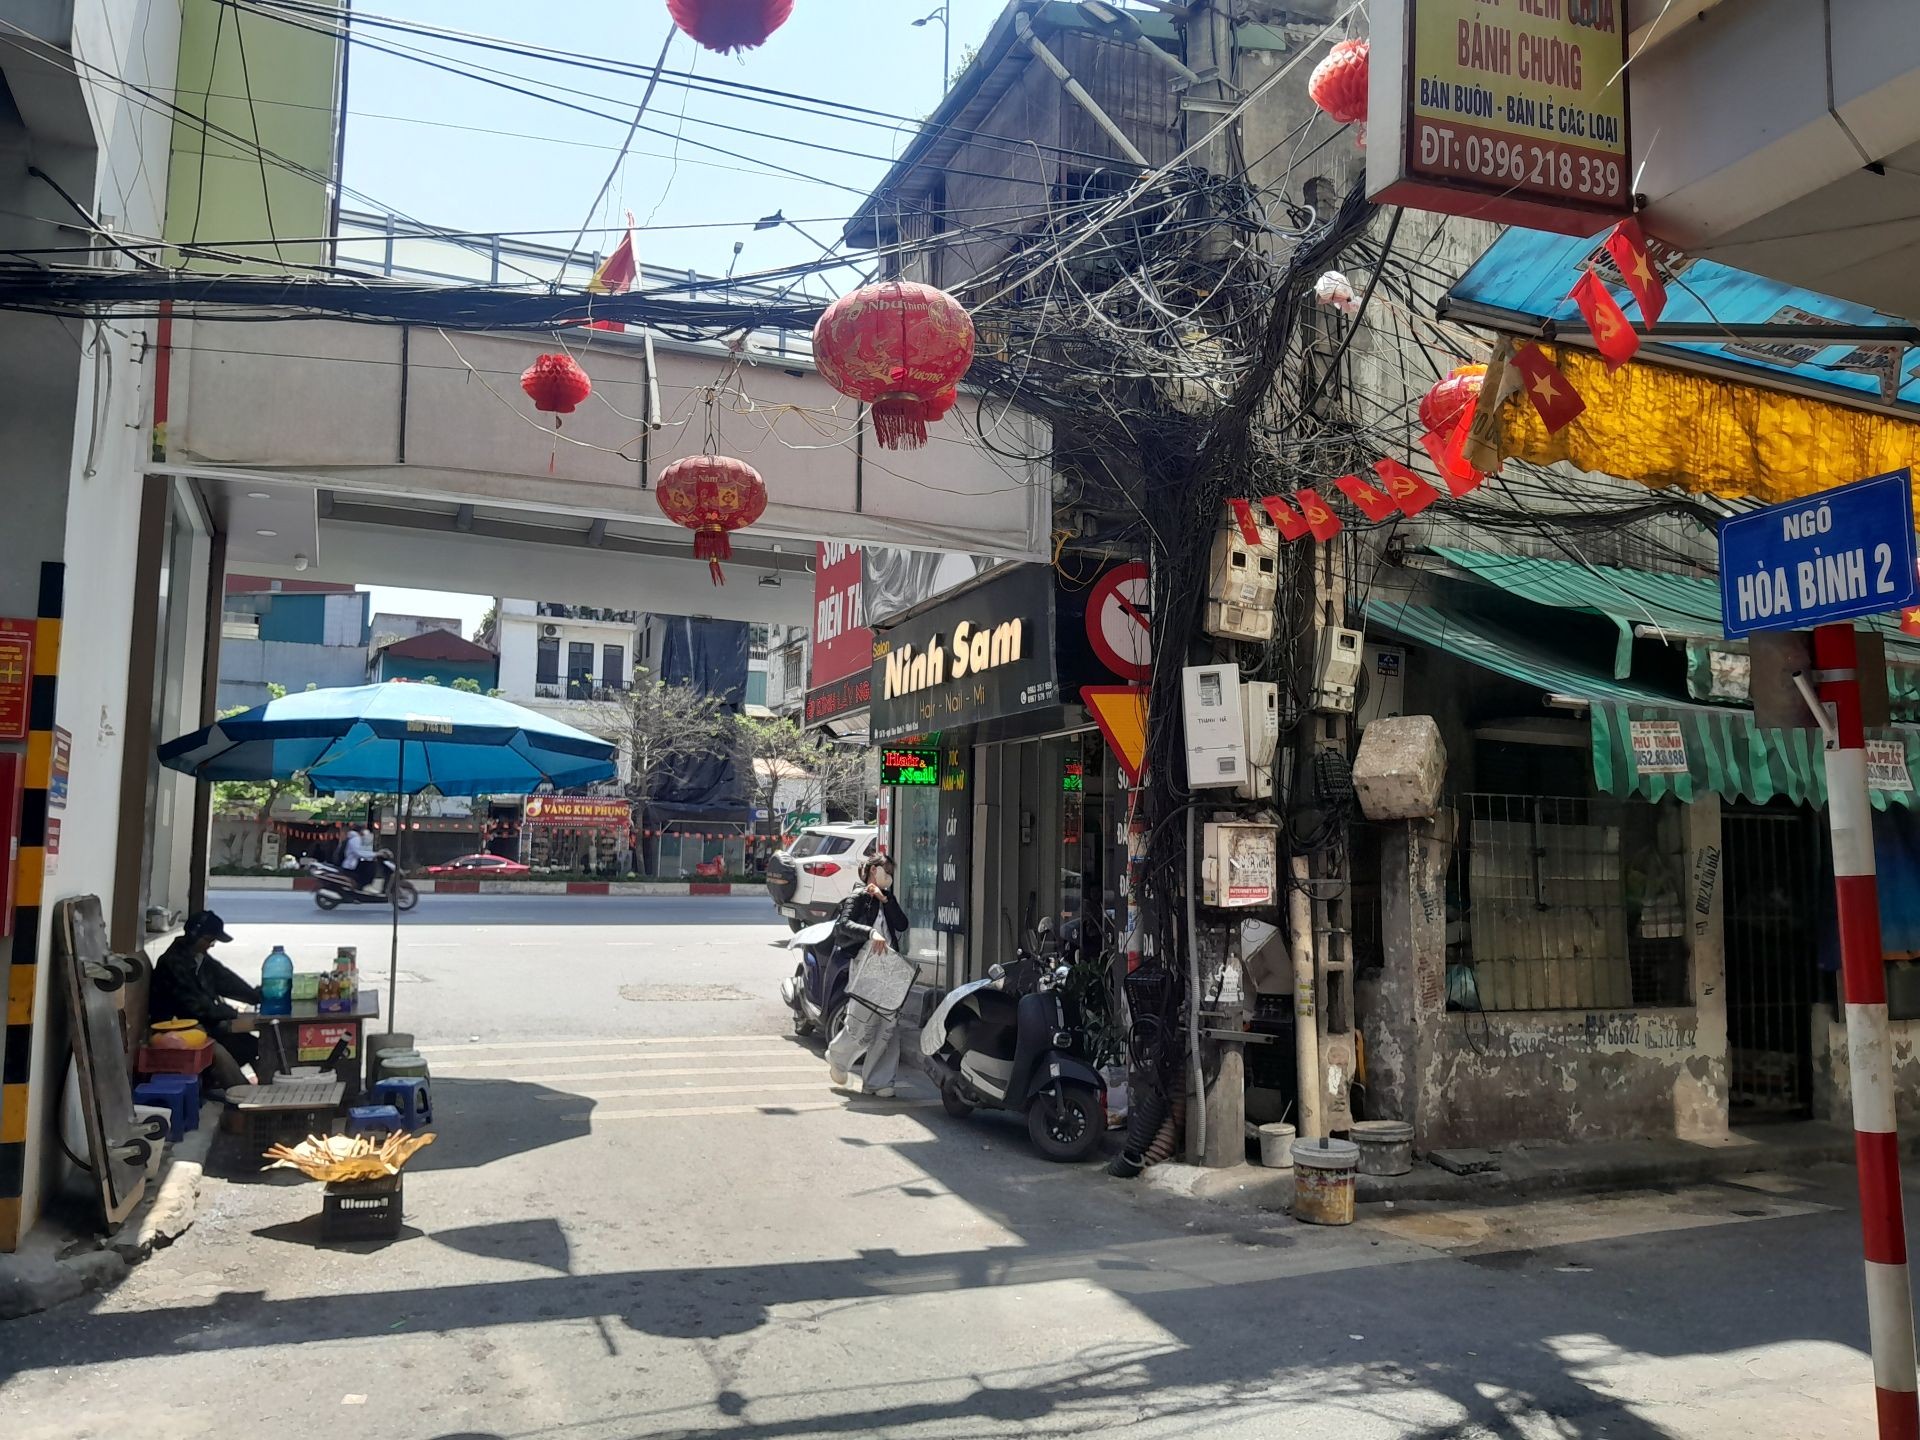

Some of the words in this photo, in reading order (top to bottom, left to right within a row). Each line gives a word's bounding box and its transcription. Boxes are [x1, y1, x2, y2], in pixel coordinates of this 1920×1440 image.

[1457, 12, 1512, 76] BÁNH
[1517, 31, 1582, 91] CHƯNG
[1420, 75, 1450, 110] BÁN
[1454, 83, 1493, 119] BUÔN
[1506, 92, 1535, 127] BÁN
[1539, 95, 1554, 131] LẺ
[1558, 103, 1585, 136] CÁC
[1589, 112, 1618, 148] LOẠI
[1420, 125, 1460, 170] ĐT:
[1465, 135, 1526, 181] 0396
[1530, 146, 1573, 190] 218
[1578, 155, 1620, 198] 339
[1782, 500, 1832, 542] NGÕ
[1737, 560, 1793, 622] HÒA
[1797, 547, 1868, 610] BÌNH
[1874, 542, 1895, 595] 2
[816, 586, 845, 650] ĐIỆN
[872, 640, 891, 658] Salon
[884, 633, 945, 701] Ninh
[951, 617, 1022, 679] Sam
[919, 699, 936, 720] Hair
[945, 689, 963, 715] Nail
[973, 684, 985, 707] Mi
[885, 752, 920, 768] Hair
[919, 759, 928, 768] &
[899, 767, 936, 784] Nail
[544, 801, 572, 815] VÀNG
[573, 805, 593, 815] KIM
[594, 805, 629, 819] PHỤNG
[943, 854, 956, 882] UỐN
[937, 902, 960, 930] NHUỘM
